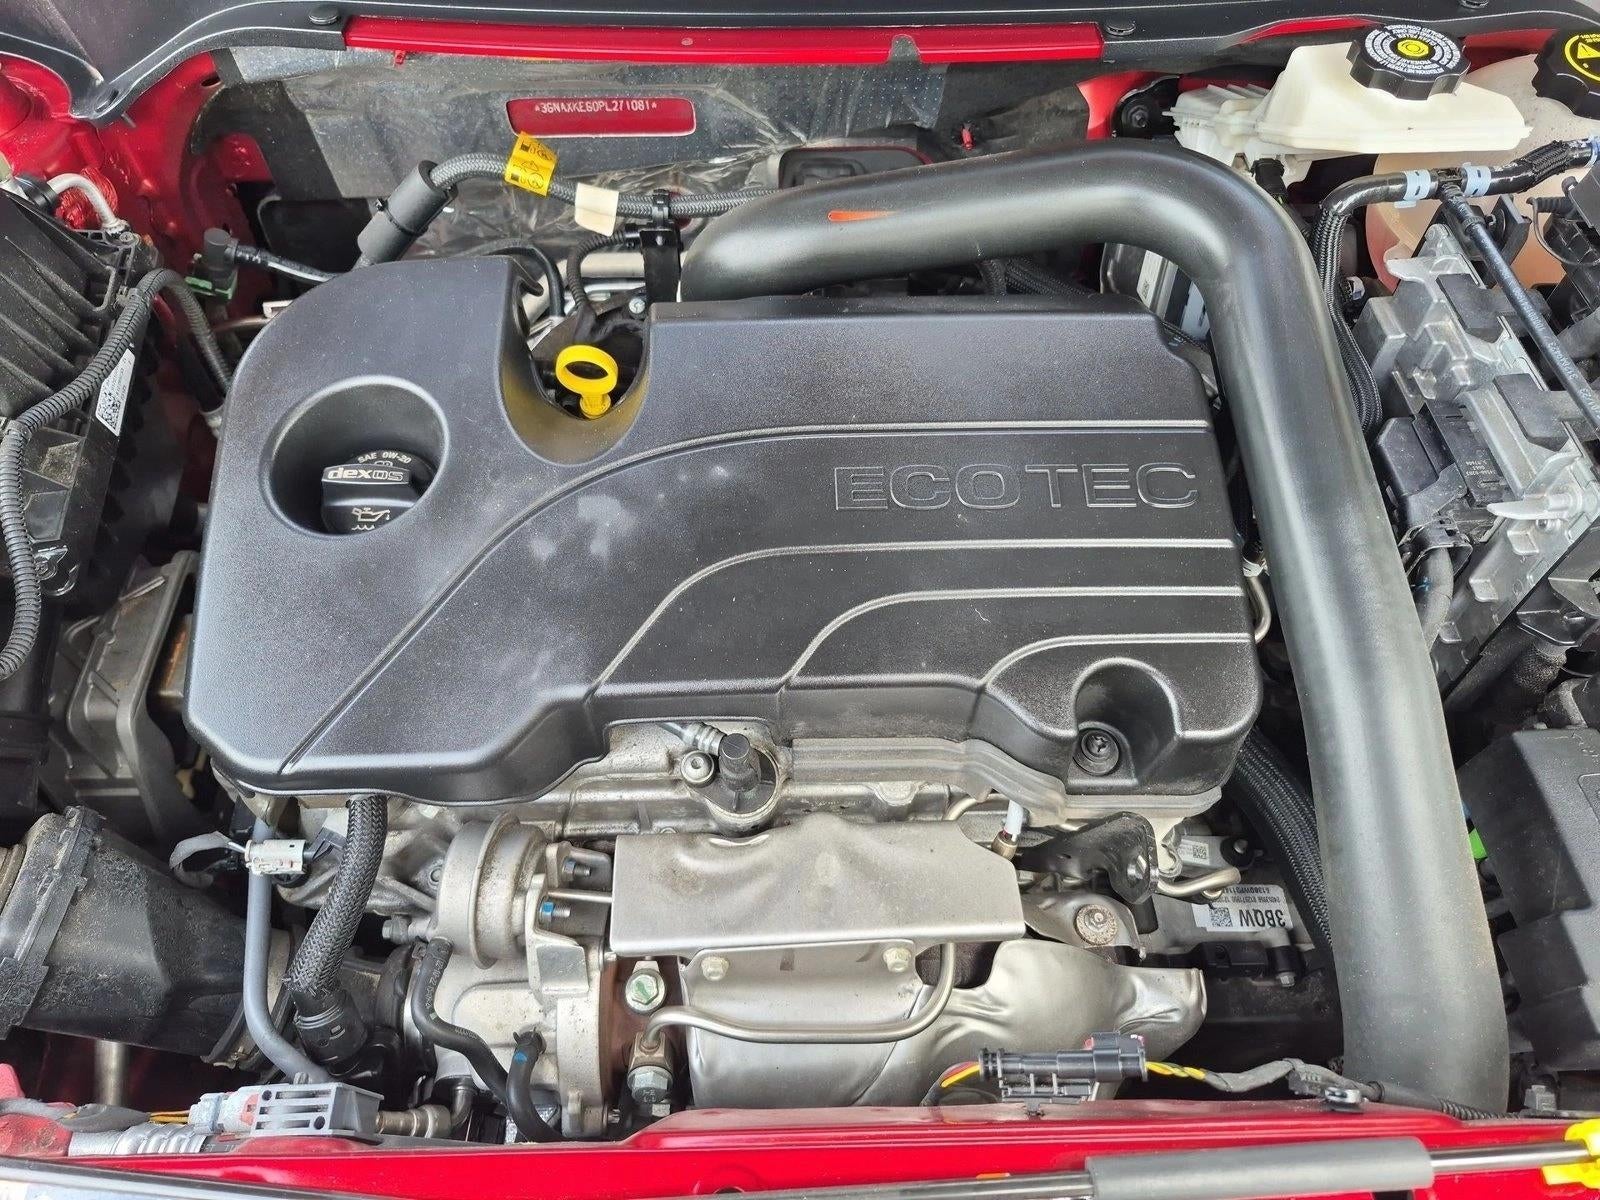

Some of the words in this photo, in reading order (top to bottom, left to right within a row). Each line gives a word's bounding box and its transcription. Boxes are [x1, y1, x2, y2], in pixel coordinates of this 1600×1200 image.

[357, 452, 378, 464] SAE
[327, 466, 404, 482] dexos
[834, 462, 1198, 511] ECOTEC
[1238, 908, 1286, 928] 3BQW
